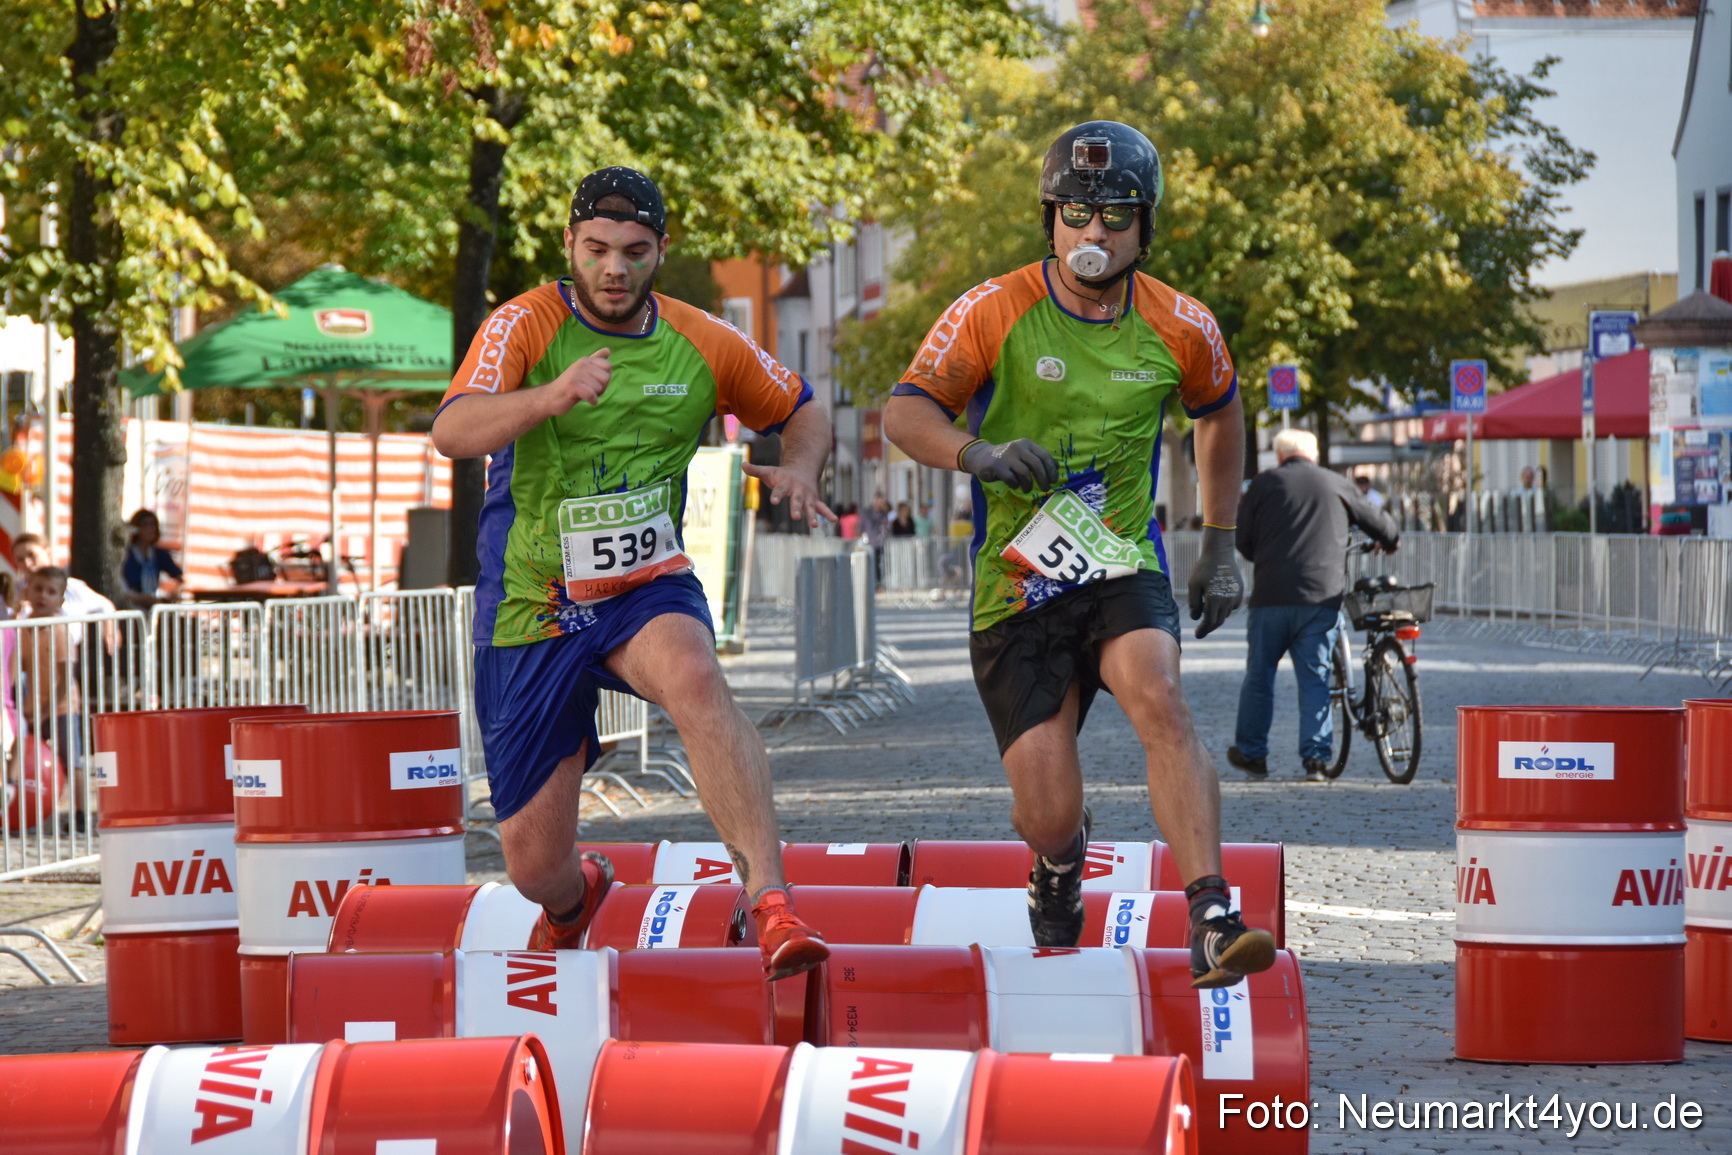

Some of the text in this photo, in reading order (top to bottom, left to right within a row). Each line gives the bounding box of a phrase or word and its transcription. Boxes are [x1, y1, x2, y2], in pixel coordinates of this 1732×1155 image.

[467, 304, 531, 393] BOCK
[911, 278, 1002, 377] BOCK
[643, 384, 688, 396] BOCK
[1111, 370, 1157, 381] BOCK
[1456, 395, 1484, 408] TAXI
[569, 488, 663, 528] BOCK
[1052, 495, 1139, 562] BOCK
[592, 527, 657, 571] 539
[131, 849, 233, 897] AVIA
[287, 869, 392, 918] AV
[1104, 926, 1113, 948] ener
[494, 951, 557, 1016] AVI
[1202, 1007, 1212, 1052] energie
